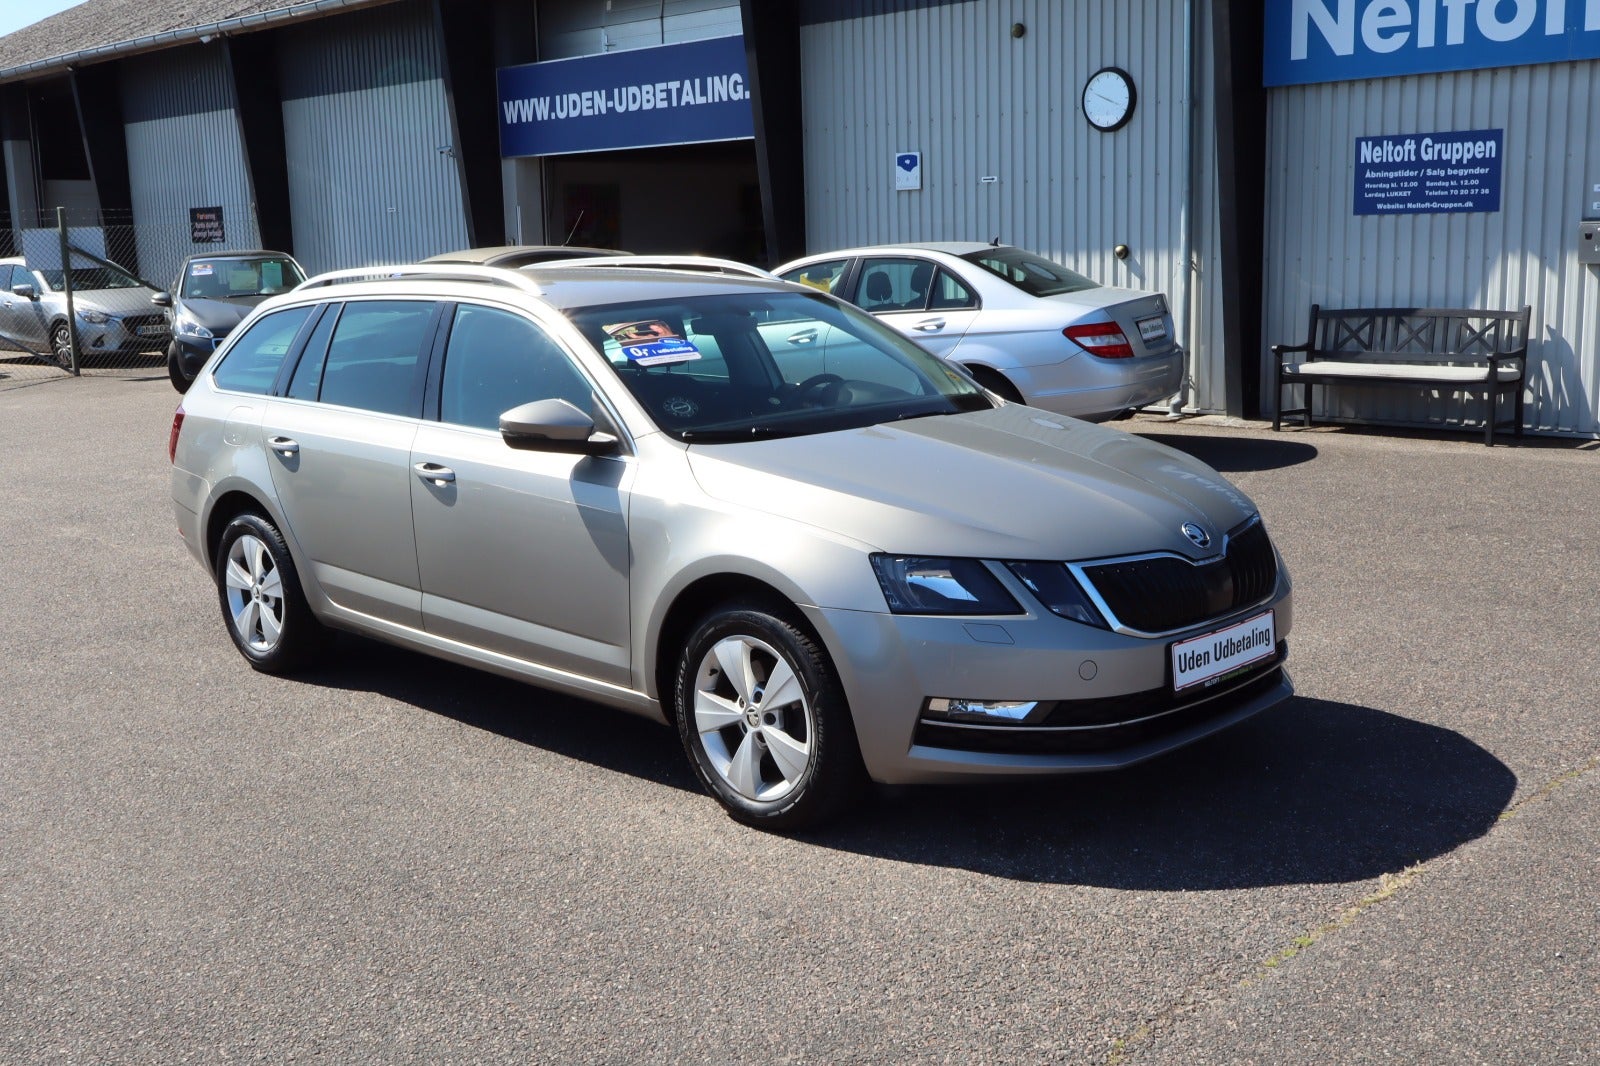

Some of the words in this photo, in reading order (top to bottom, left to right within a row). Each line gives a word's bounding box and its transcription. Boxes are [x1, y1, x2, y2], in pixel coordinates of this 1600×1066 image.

[503, 73, 750, 124] WWW.UDEN-UDBETALING.
[1360, 139, 1416, 164] Neltoft
[1420, 137, 1496, 164] Gruppen
[1365, 169, 1418, 178] Åbningstider
[1426, 168, 1445, 177] Salg
[1447, 167, 1490, 176] begynder
[1178, 650, 1210, 674] Uden
[1213, 628, 1271, 662] Udbetaling
